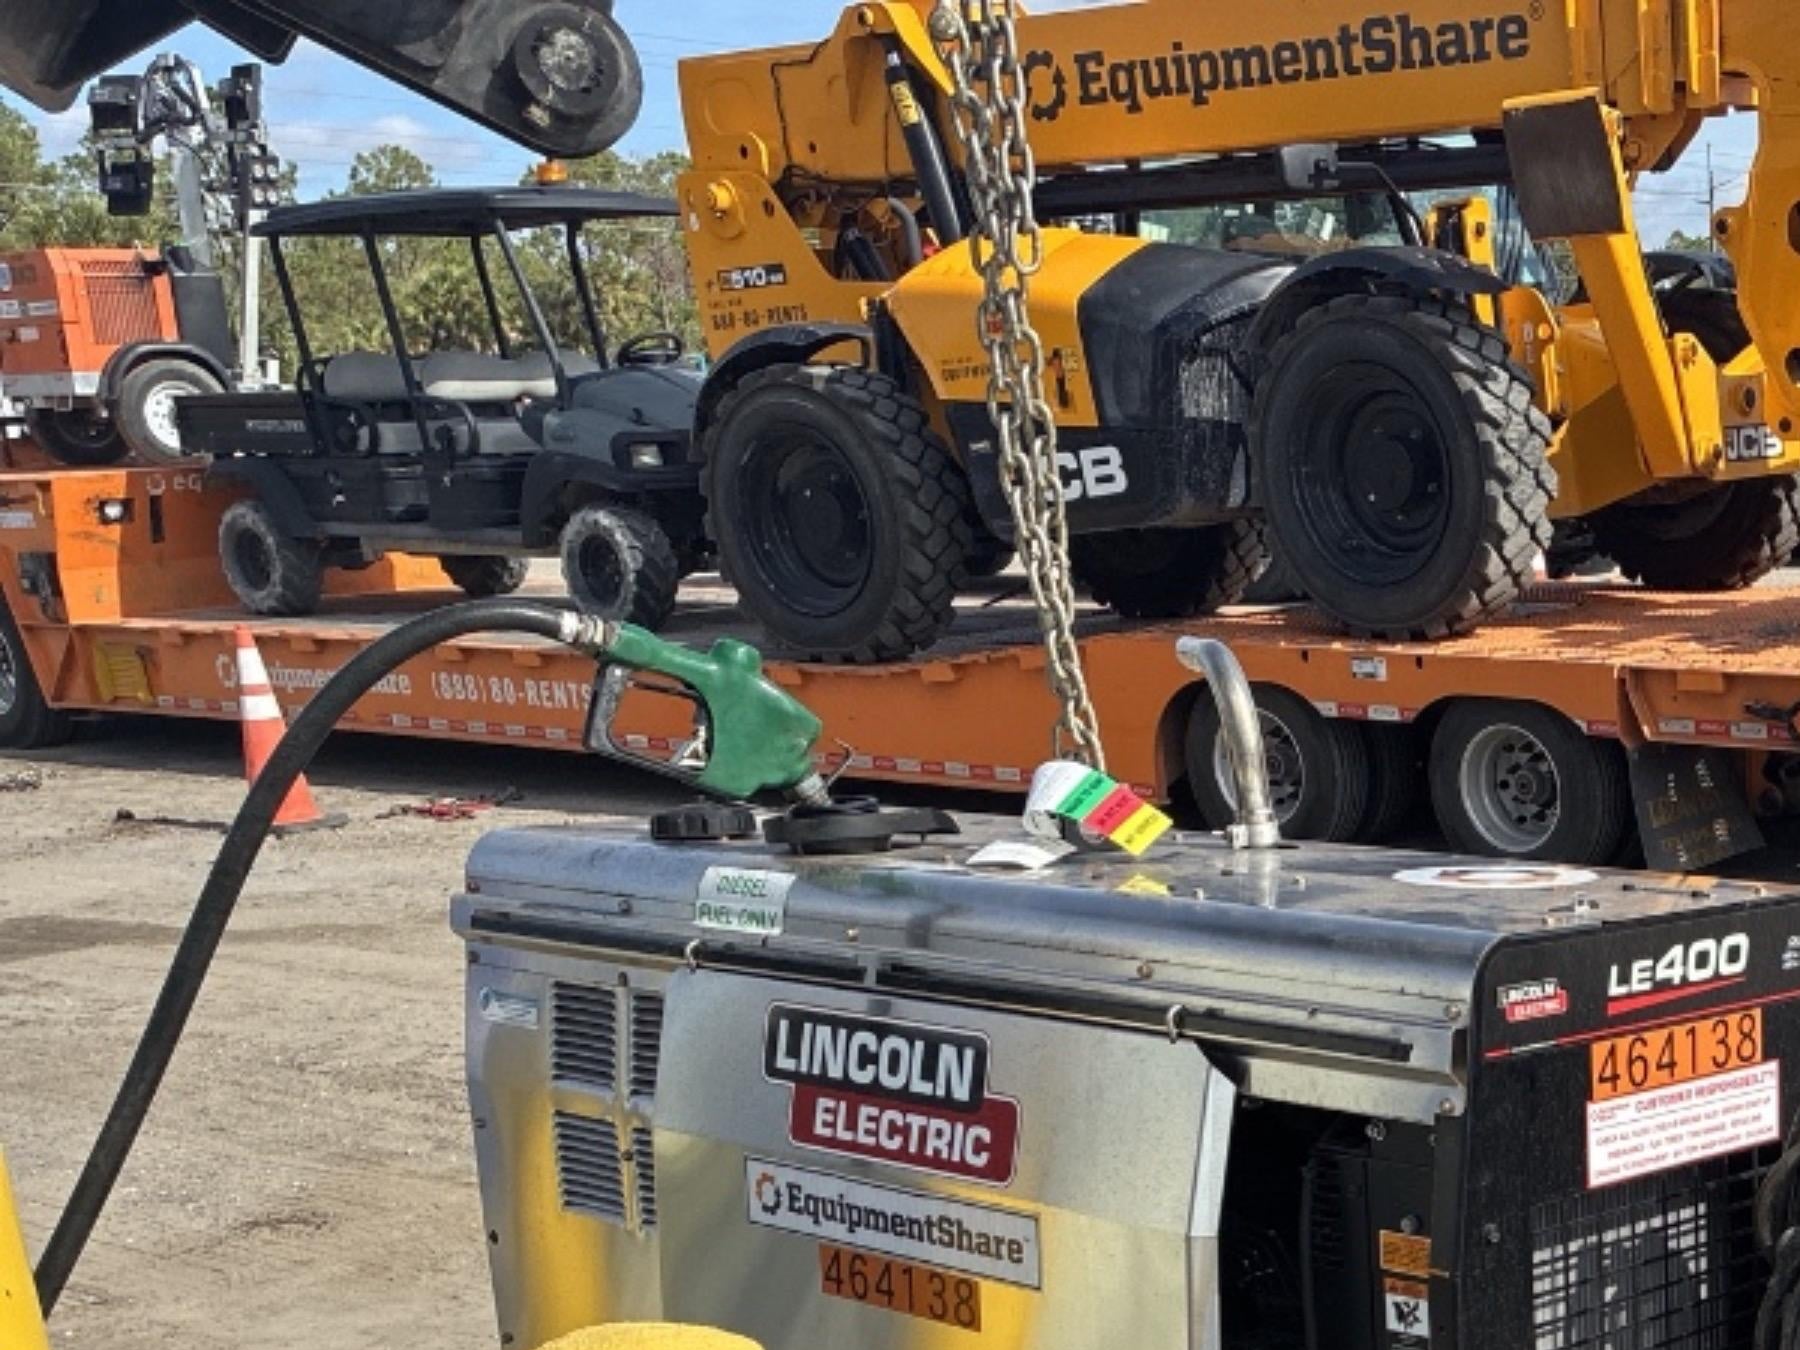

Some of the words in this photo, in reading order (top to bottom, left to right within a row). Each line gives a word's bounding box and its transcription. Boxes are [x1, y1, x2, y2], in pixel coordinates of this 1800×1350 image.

[1040, 446, 1128, 502] CB
[1726, 425, 1784, 460] JCB
[1607, 932, 1750, 998] LE400
[775, 1019, 976, 1102] LINCOLN
[1598, 1014, 1757, 1093] 464138
[813, 1097, 991, 1168] ELECTRIC
[785, 1182, 1024, 1265] EquipmentShare
[824, 1249, 977, 1328] 464138
